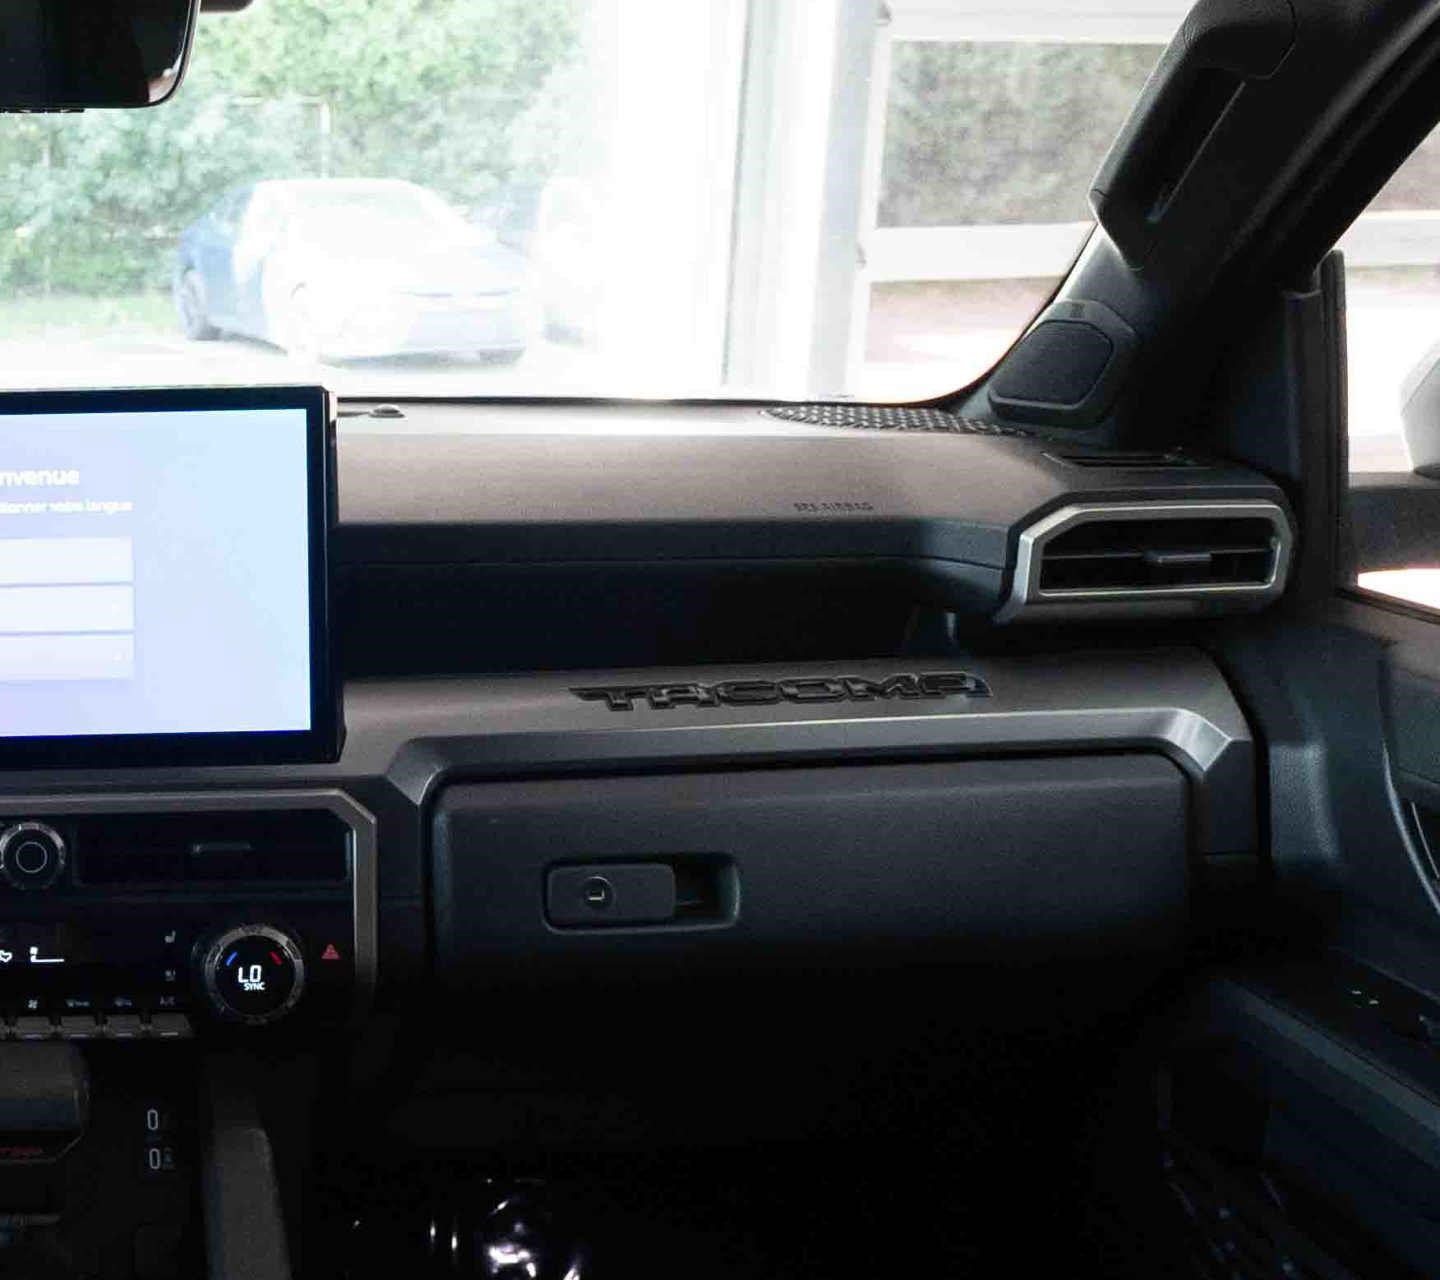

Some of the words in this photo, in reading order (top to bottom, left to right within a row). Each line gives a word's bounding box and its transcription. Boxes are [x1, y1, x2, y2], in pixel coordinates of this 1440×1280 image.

[568, 672, 993, 712] TACOMA
[237, 964, 262, 984] LO
[243, 982, 266, 992] SYNC
